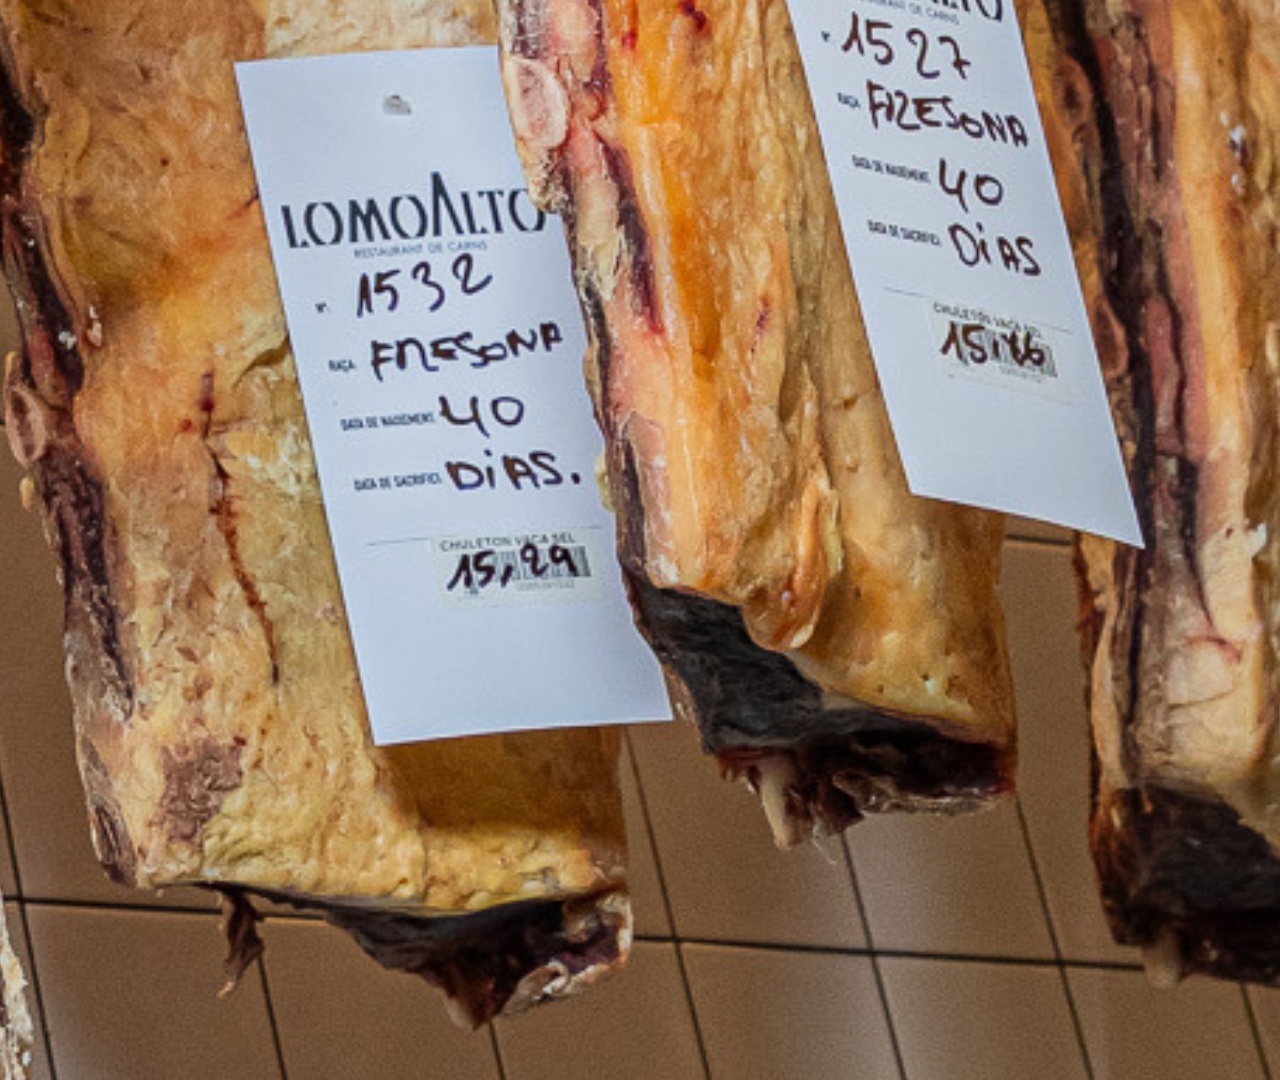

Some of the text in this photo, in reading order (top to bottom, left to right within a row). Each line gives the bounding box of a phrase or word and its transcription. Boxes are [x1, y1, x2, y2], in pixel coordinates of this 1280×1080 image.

[841, 10, 971, 80] 1527
[280, 171, 547, 249] LOMOALTO
[938, 157, 1004, 214] 40
[356, 252, 493, 319] 1532
[438, 394, 525, 439] 40
